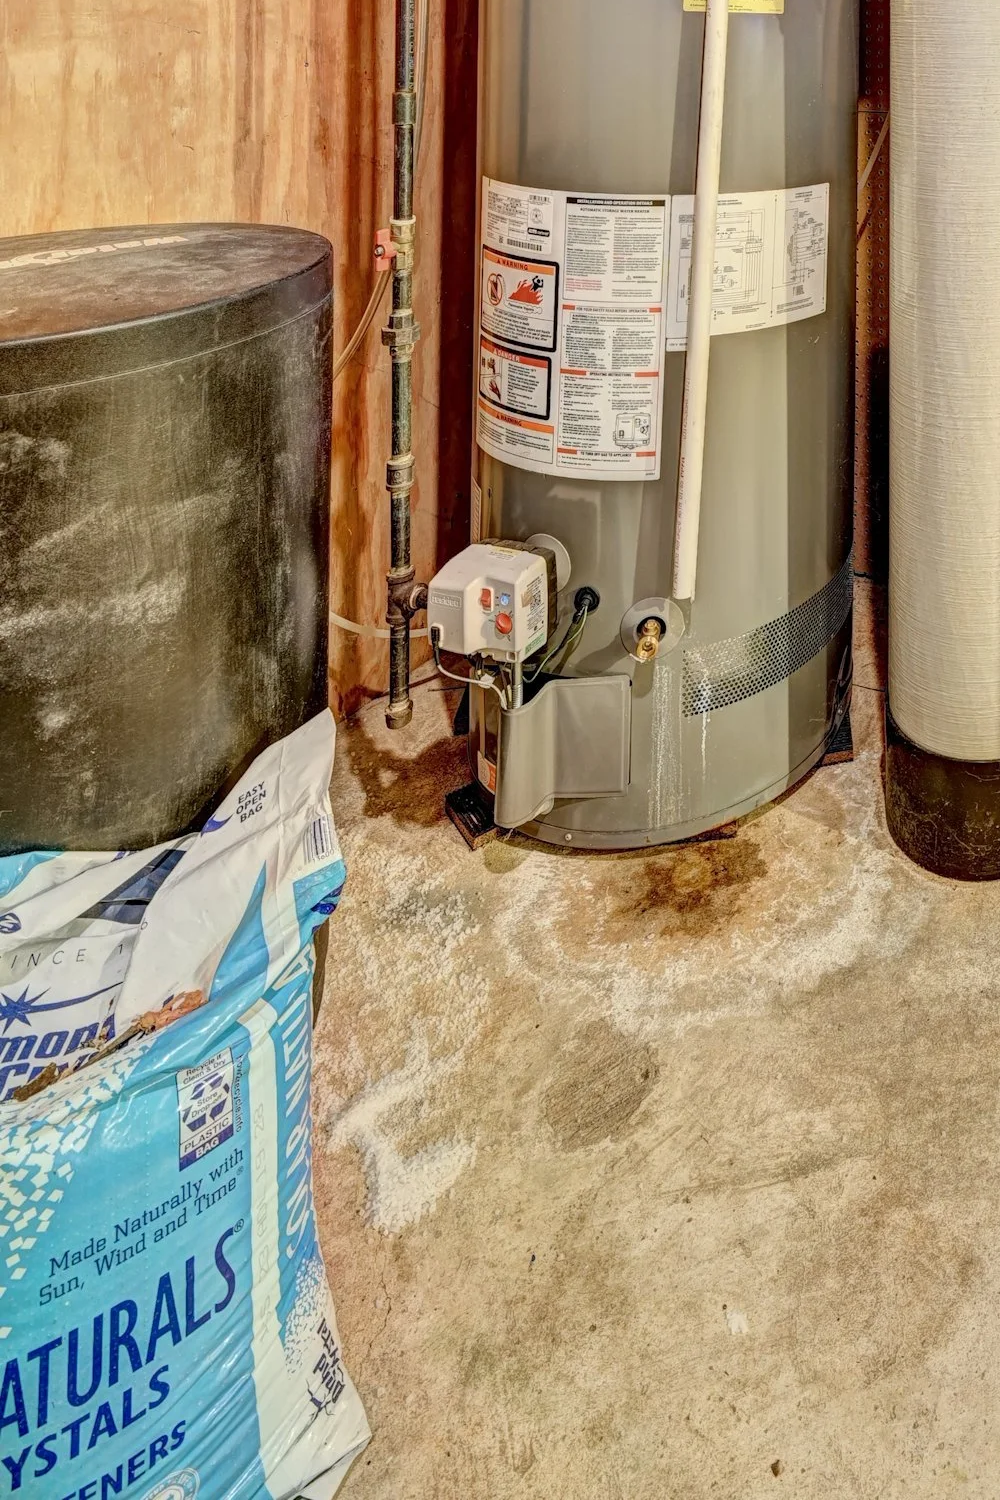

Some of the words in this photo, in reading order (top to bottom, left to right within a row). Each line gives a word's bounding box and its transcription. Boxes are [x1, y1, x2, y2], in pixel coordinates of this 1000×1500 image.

[502, 258, 528, 271] WARNING
[235, 789, 267, 815] OPEN
[237, 780, 265, 805] EASY
[239, 802, 263, 823] BAG
[0, 948, 87, 970] INCE
[182, 1070, 205, 1086] Clean
[212, 1059, 226, 1071] Dry
[186, 1056, 215, 1077] Recycle
[197, 1091, 219, 1107] Store
[184, 1116, 230, 1153] PLASTIC
[195, 1137, 220, 1160] BAG
[49, 1236, 107, 1278] Made
[114, 1179, 204, 1244] Naturally
[209, 1147, 244, 1183] with
[39, 1273, 86, 1307] Sun,
[94, 1237, 147, 1277] Wind
[153, 1210, 188, 1244] and
[1, 1363, 172, 1493] YSTALS
